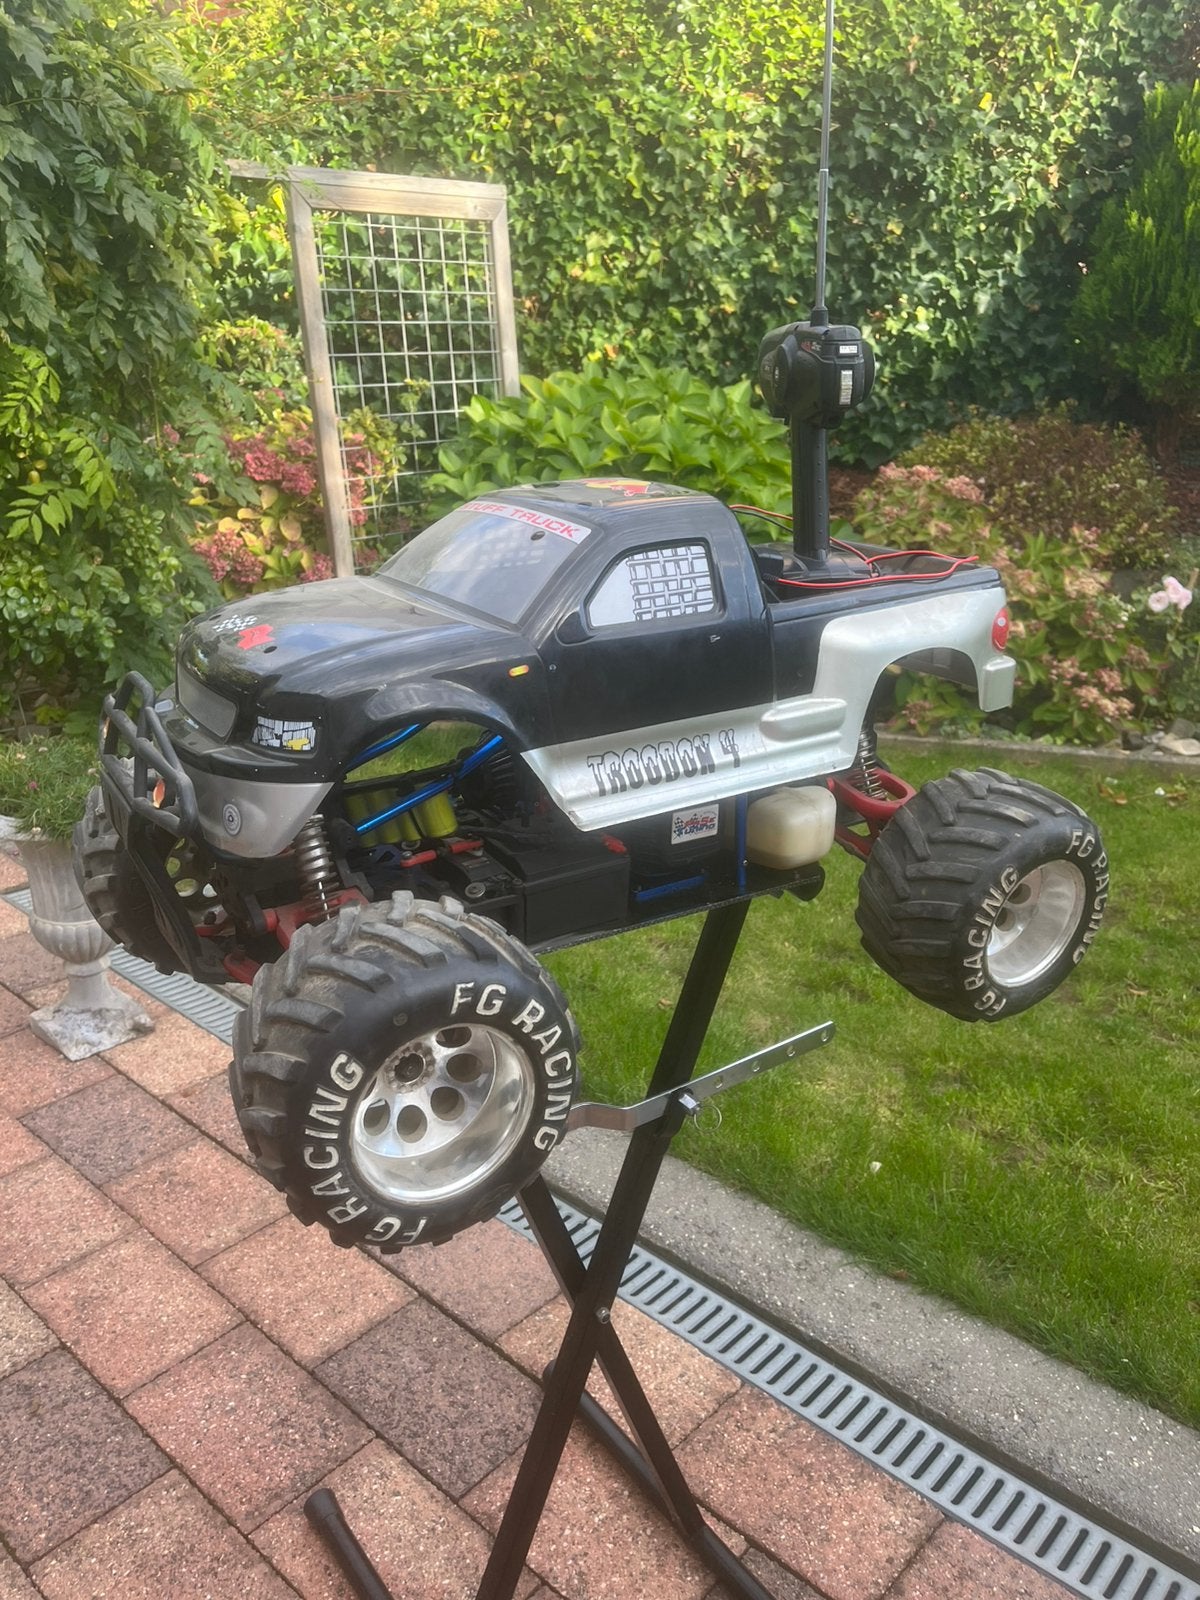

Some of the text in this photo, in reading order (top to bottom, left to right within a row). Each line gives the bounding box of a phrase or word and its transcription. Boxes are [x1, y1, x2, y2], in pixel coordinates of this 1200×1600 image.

[510, 509, 580, 537] TRUCK
[587, 728, 741, 796] TROODON 4
[1065, 831, 1095, 857] FG
[963, 865, 1019, 1017] FG RACING
[451, 982, 573, 1152] FG RACING
[303, 1051, 428, 1245] FG RACING
